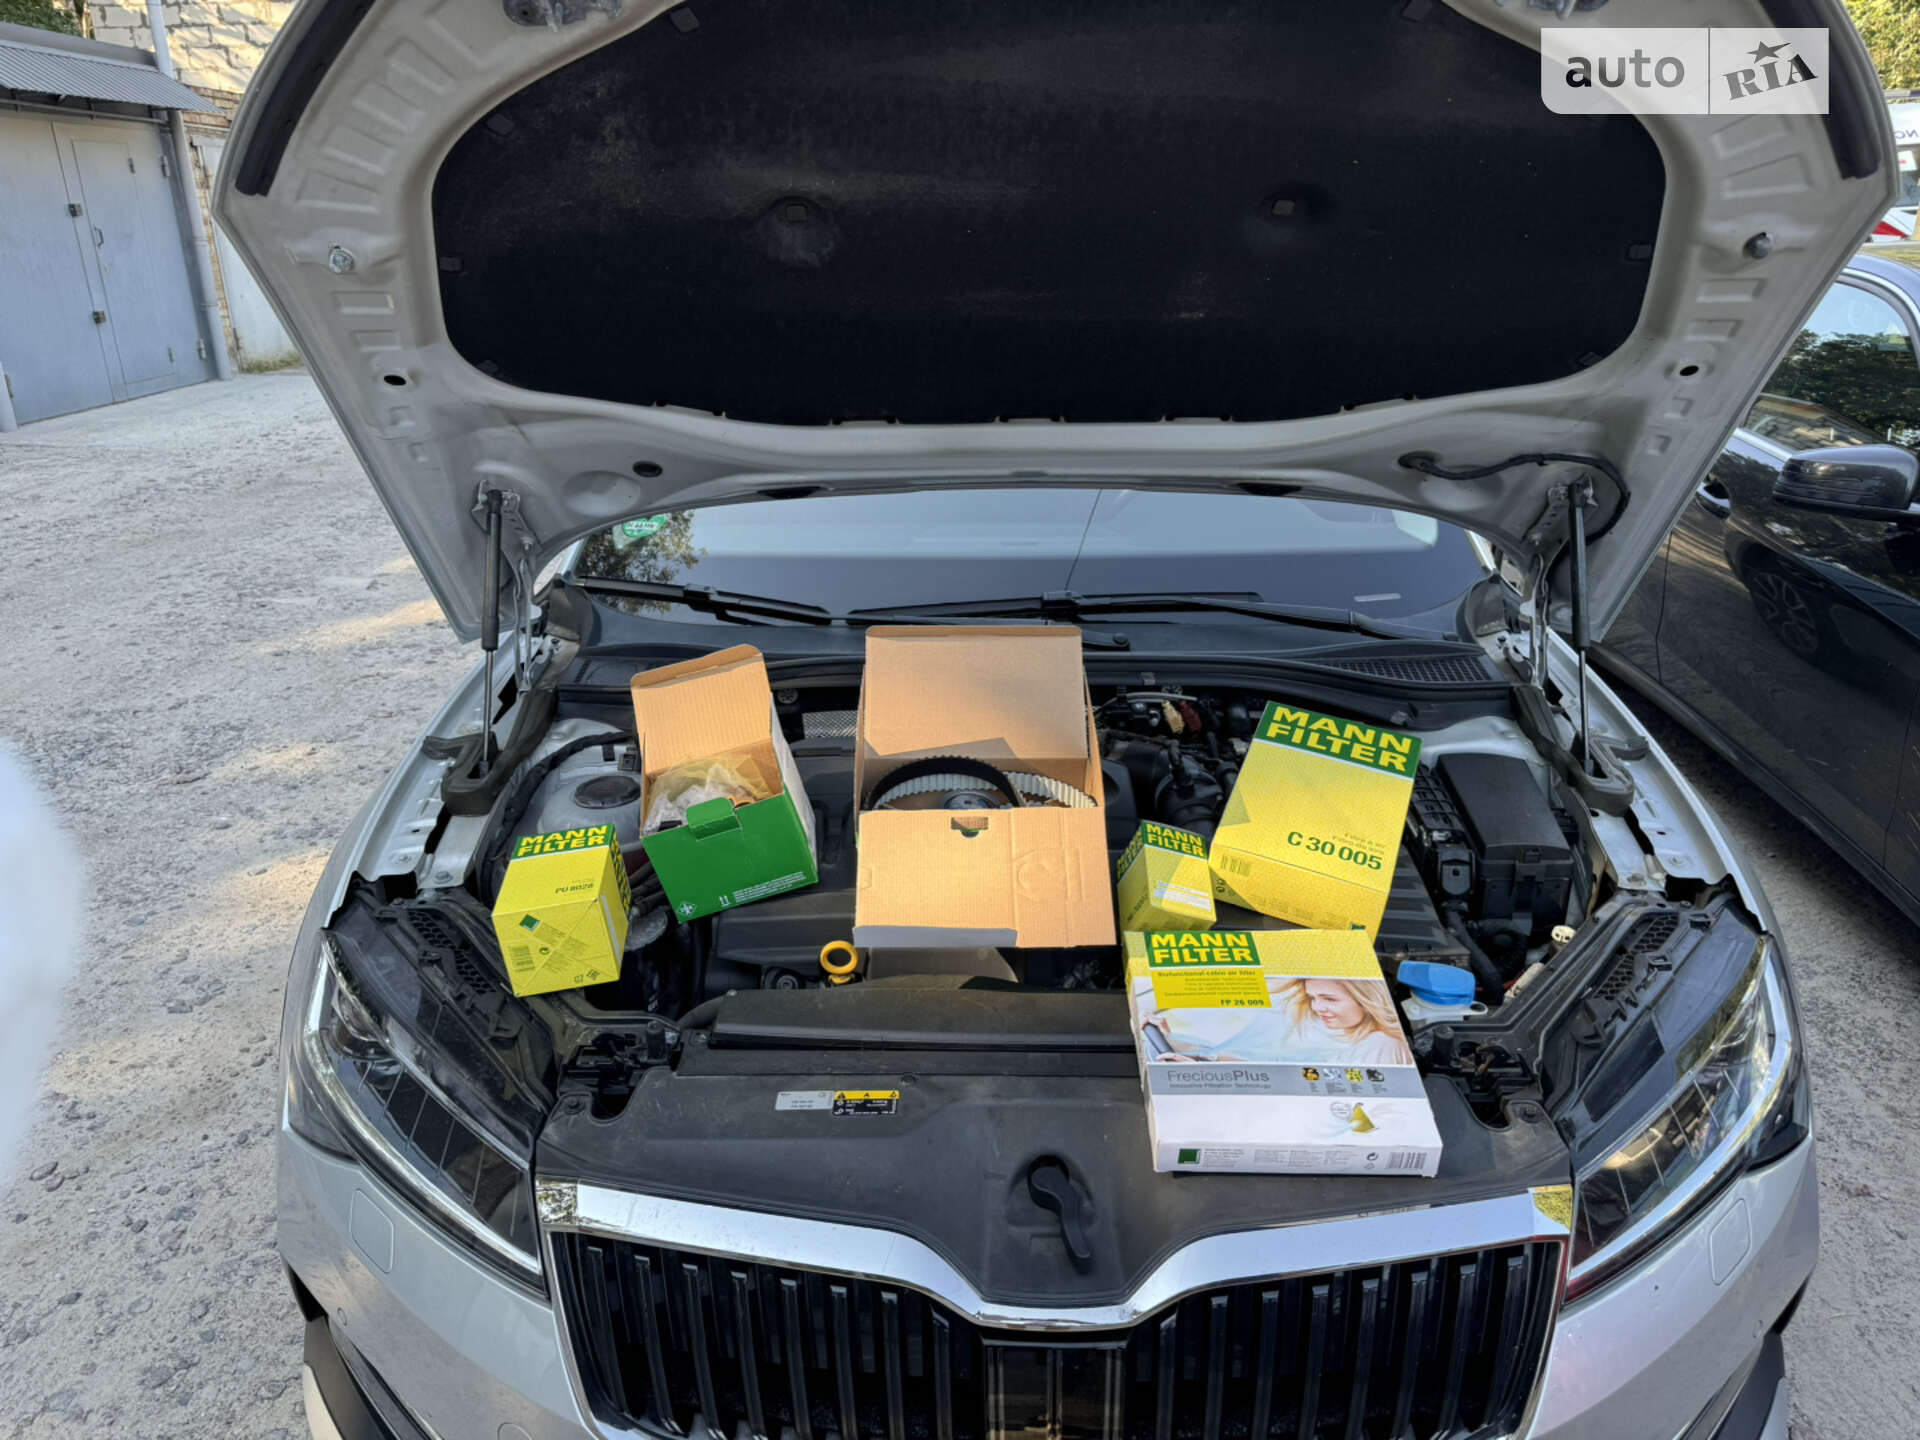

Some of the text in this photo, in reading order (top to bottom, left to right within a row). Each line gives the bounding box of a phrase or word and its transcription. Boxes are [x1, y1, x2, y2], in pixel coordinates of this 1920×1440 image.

[1272, 706, 1413, 754] MANN
[1266, 722, 1408, 772] FILTER
[517, 835, 605, 857] FILTER
[521, 825, 608, 847] MANN
[1146, 824, 1202, 846] MANN
[1148, 834, 1204, 857] FILTER
[1287, 831, 1304, 846] C
[1338, 846, 1383, 870] 005
[1150, 932, 1249, 948] MANN
[1153, 948, 1255, 964] FILTER
[1167, 1070, 1270, 1082] FreciousPlus
